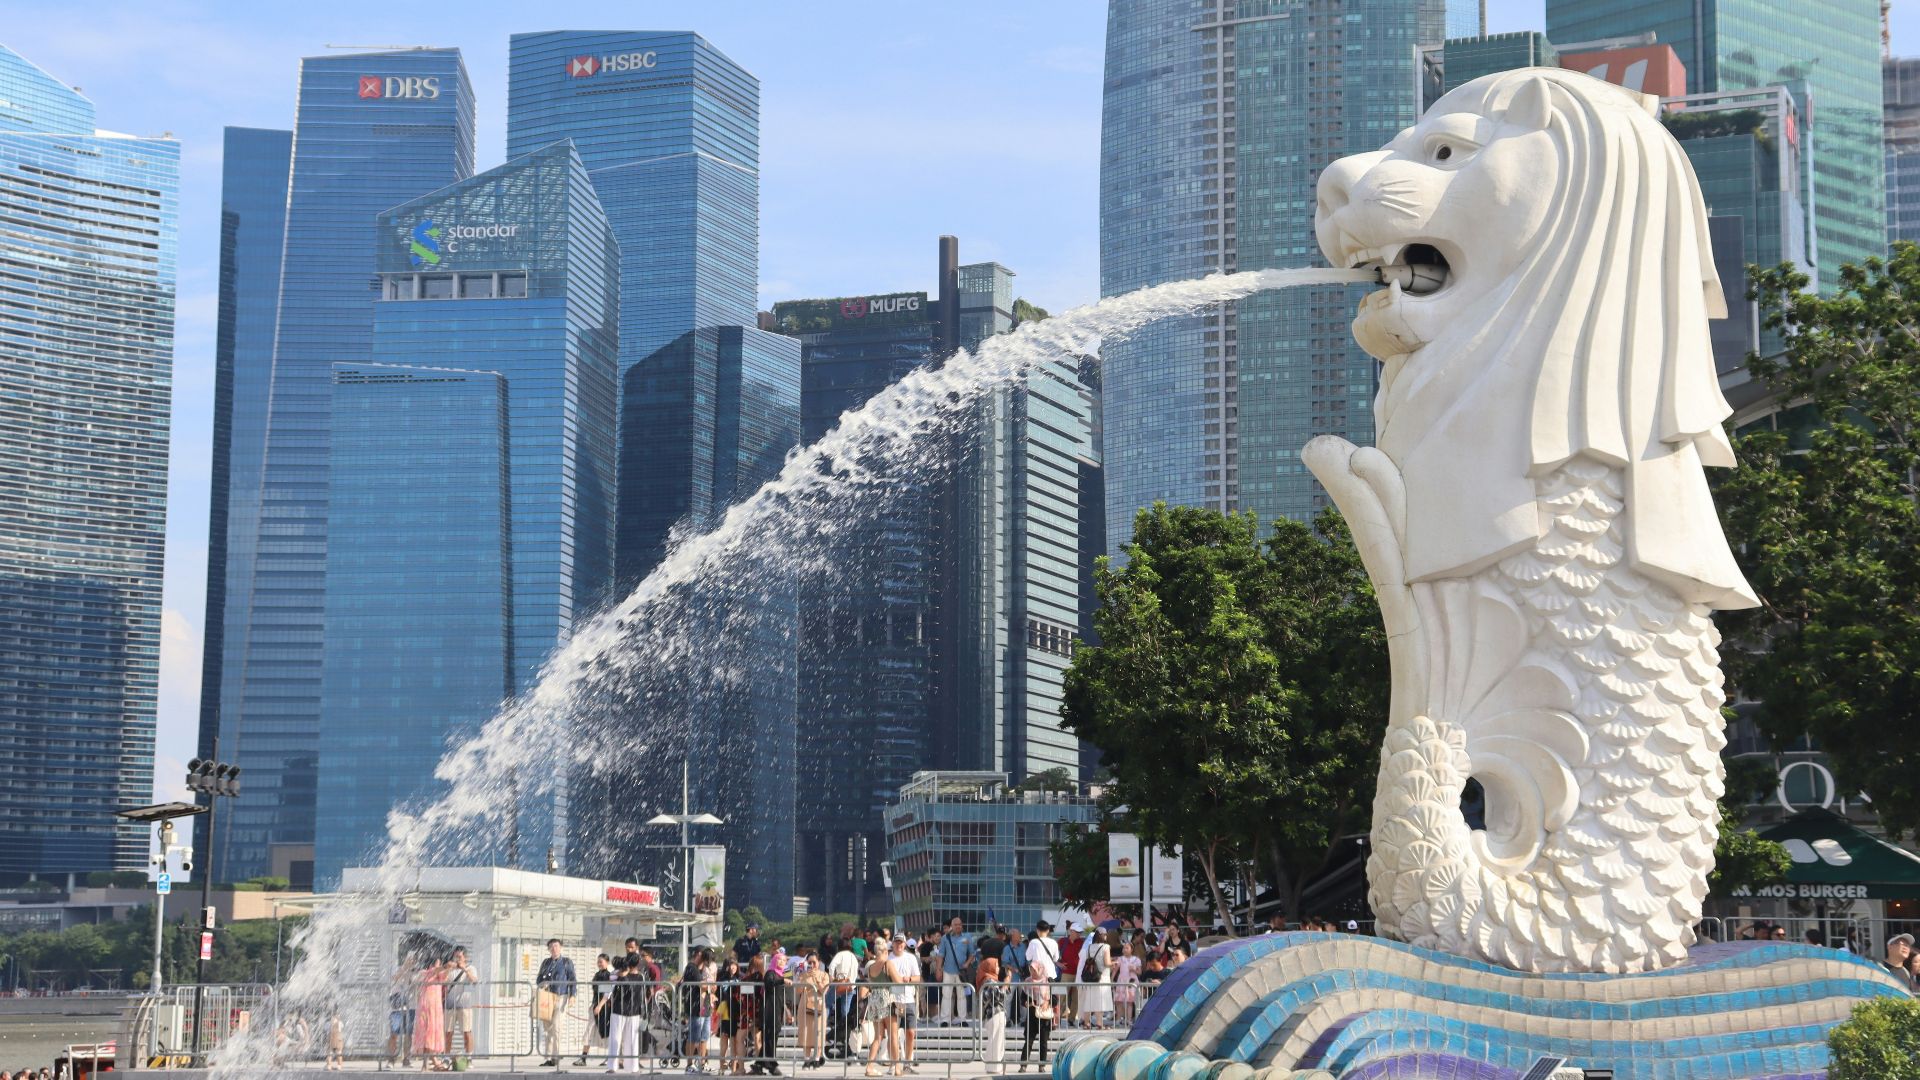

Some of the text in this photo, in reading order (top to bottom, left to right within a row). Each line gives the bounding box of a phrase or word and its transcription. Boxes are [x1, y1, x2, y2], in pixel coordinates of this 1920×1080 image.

[602, 51, 657, 72] HSBC
[384, 76, 440, 99] DBS
[870, 297, 919, 313] MUFG
[1756, 884, 1797, 898] MOS
[1800, 884, 1868, 898] BURGER
